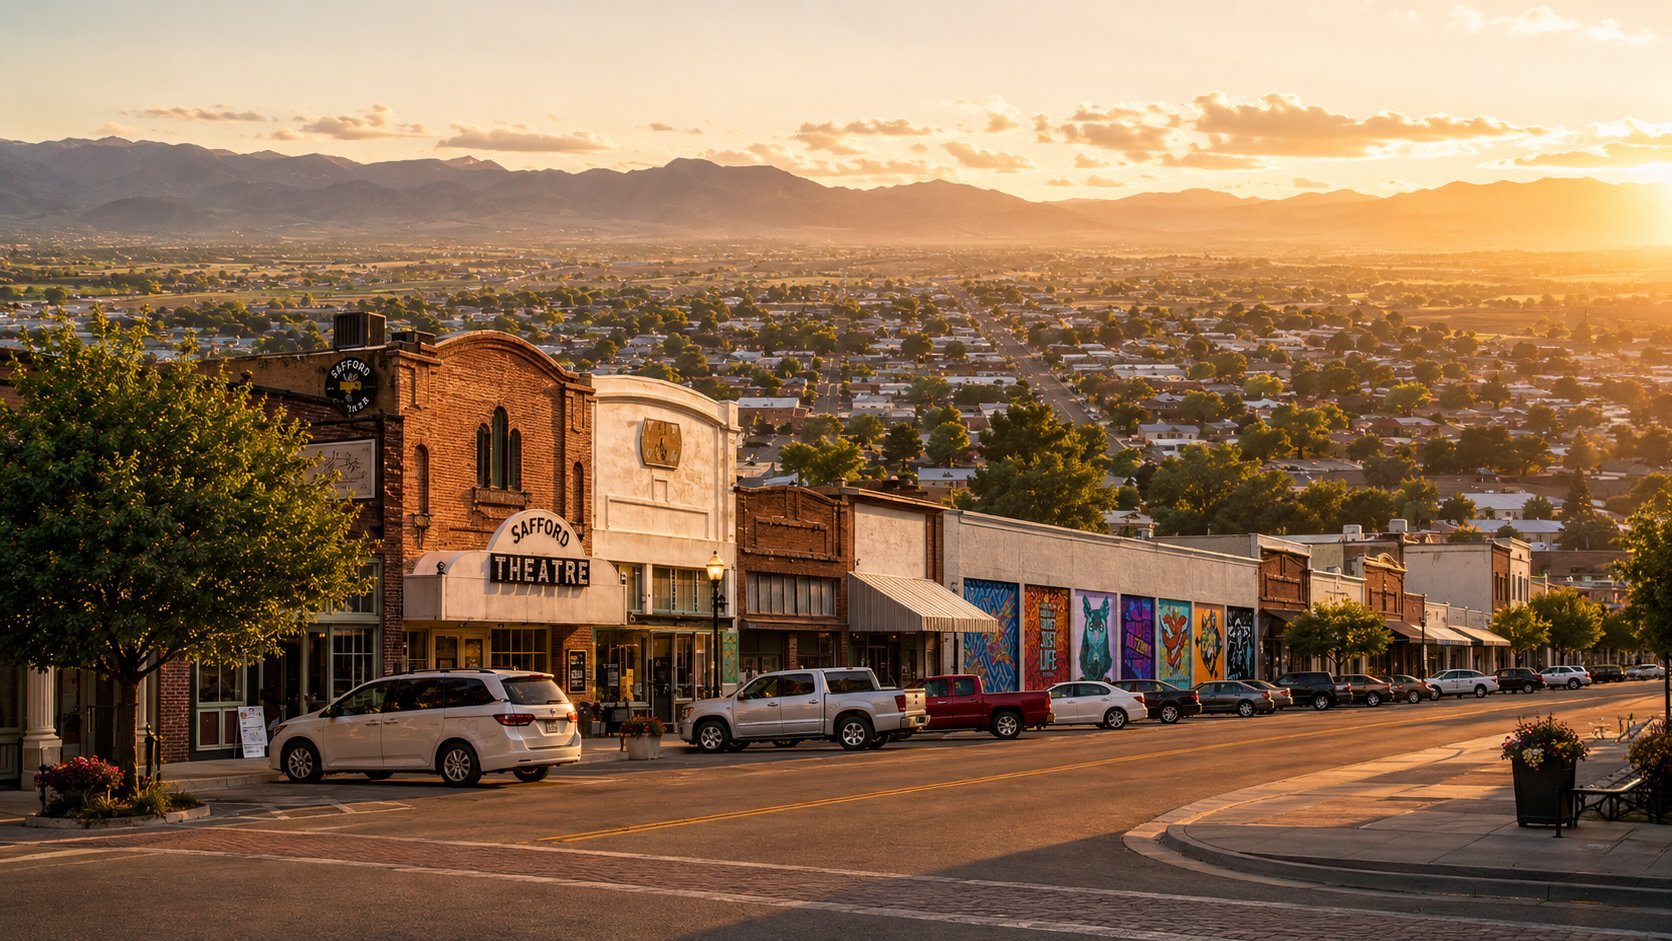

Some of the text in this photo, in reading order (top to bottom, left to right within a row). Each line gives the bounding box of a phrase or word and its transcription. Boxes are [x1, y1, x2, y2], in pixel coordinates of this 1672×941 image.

[331, 360, 370, 379] SAFFORD
[511, 517, 570, 547] SAFFORD
[494, 556, 588, 585] THEATRE
[1040, 649, 1057, 671] LIFE
